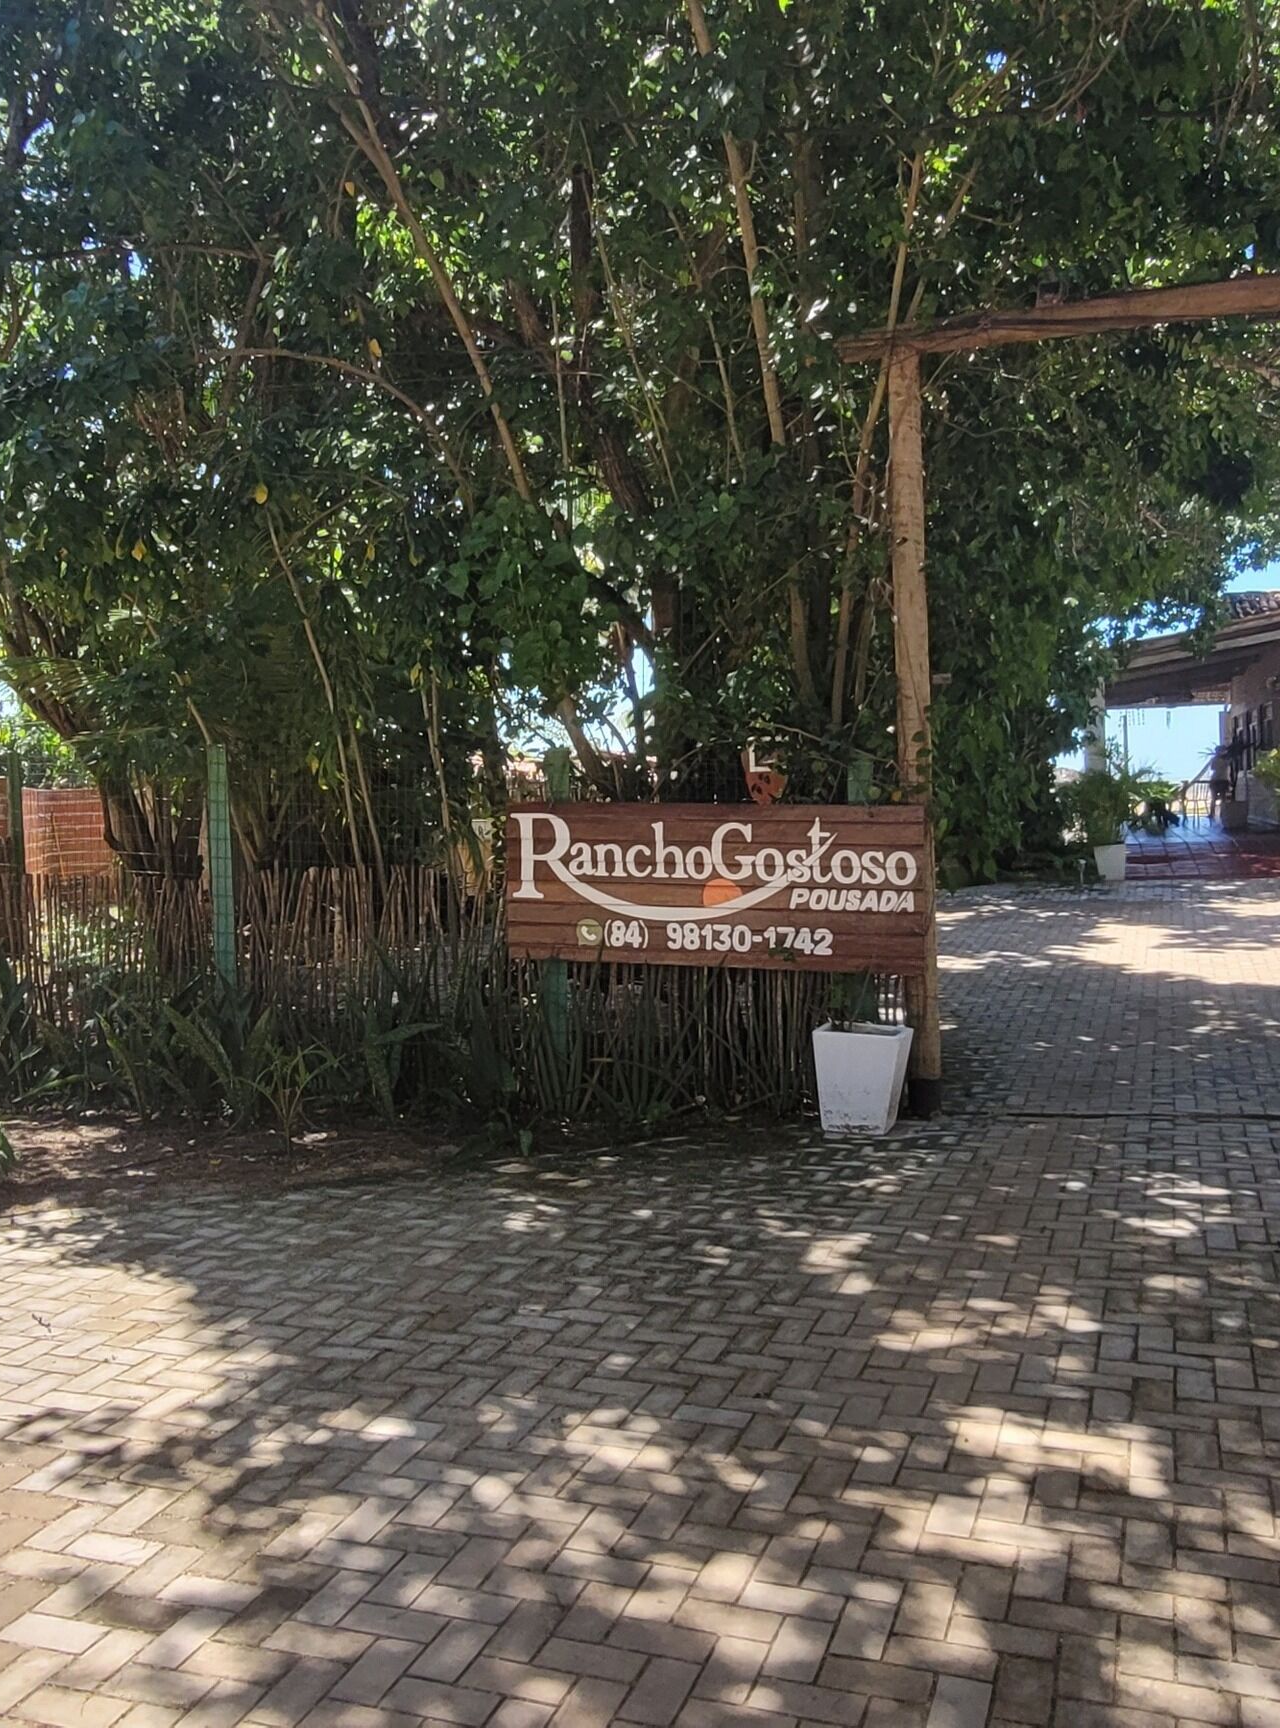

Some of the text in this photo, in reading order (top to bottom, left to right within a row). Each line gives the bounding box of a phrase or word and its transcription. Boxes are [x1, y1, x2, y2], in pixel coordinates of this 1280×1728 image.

[789, 888, 915, 913] POUSADA
[604, 919, 834, 956] (84) 98130-1742
